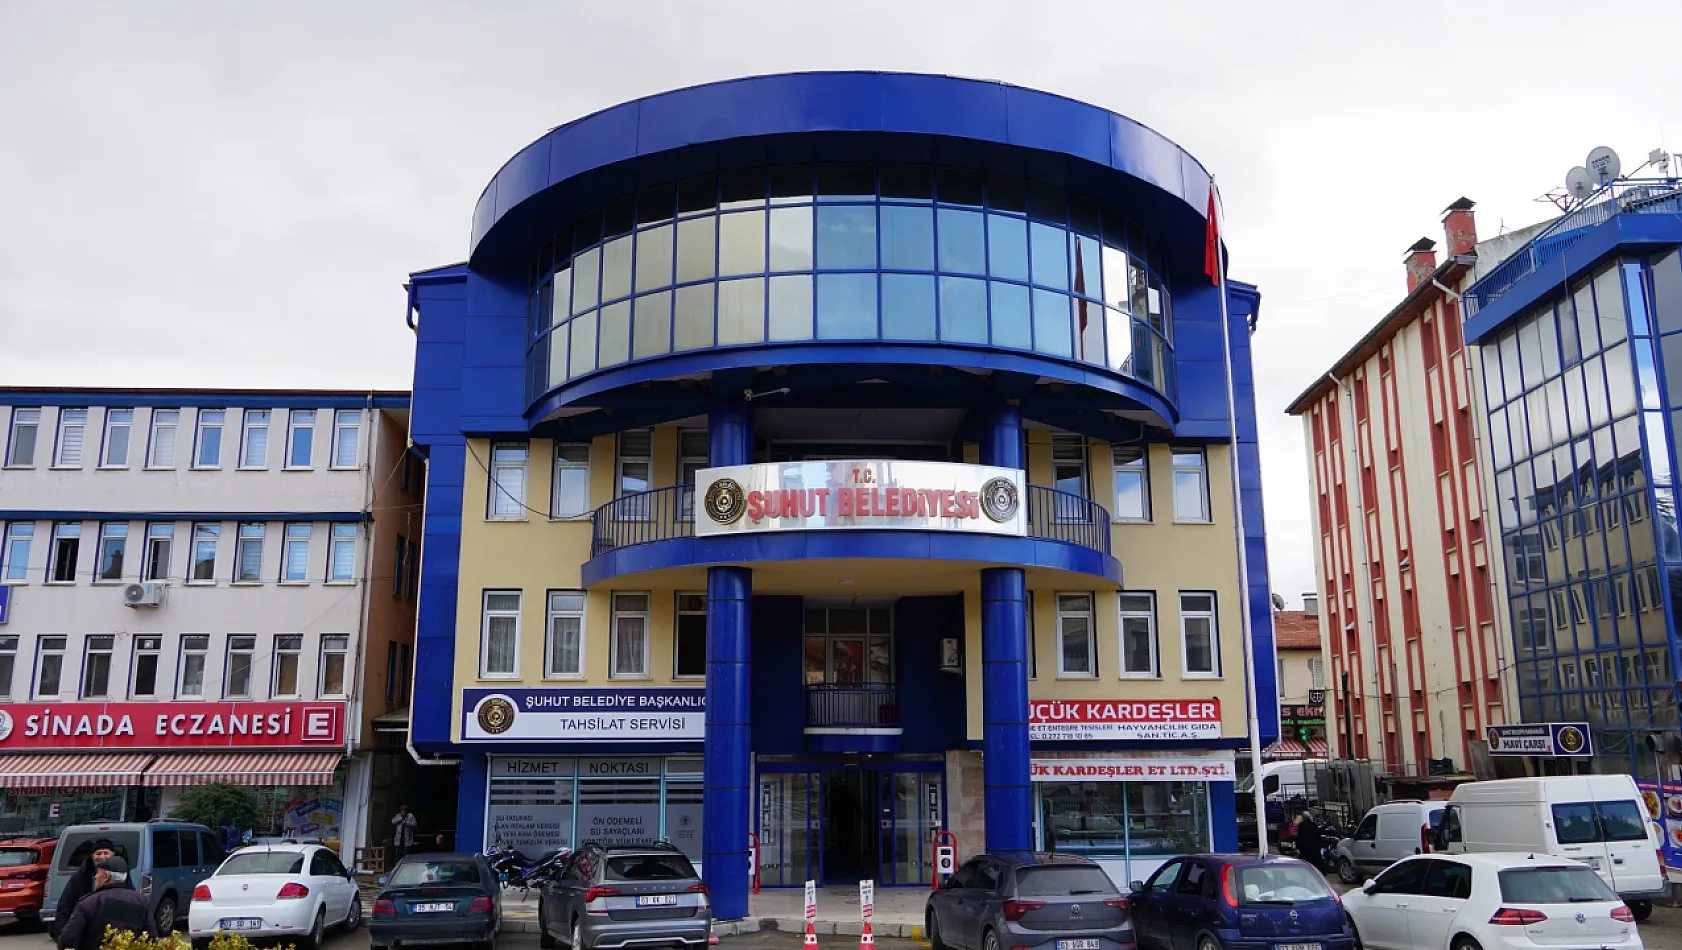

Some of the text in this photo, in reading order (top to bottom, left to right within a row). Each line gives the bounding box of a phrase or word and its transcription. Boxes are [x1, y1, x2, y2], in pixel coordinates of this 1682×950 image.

[853, 468, 876, 484] T.C.
[747, 487, 980, 524] ŞUHUT BELEDİYESİ
[525, 695, 570, 709] ŞUHUT
[573, 693, 636, 707] BELEDİYE
[1086, 702, 1216, 723] KARDEŞLER
[24, 707, 330, 737] SİNADA ECZANESİ E
[560, 716, 686, 731] TAHSİLAT SERVİSİ
[1191, 723, 1217, 731] GIDA
[507, 759, 649, 774] HİZMET NOKTASI
[1052, 765, 1144, 777] KARDEŞLER
[1147, 765, 1166, 776] ET
[593, 816, 642, 825] ÖN ÖDEMELİ
[590, 828, 645, 837] SU SAYAÇLARI
